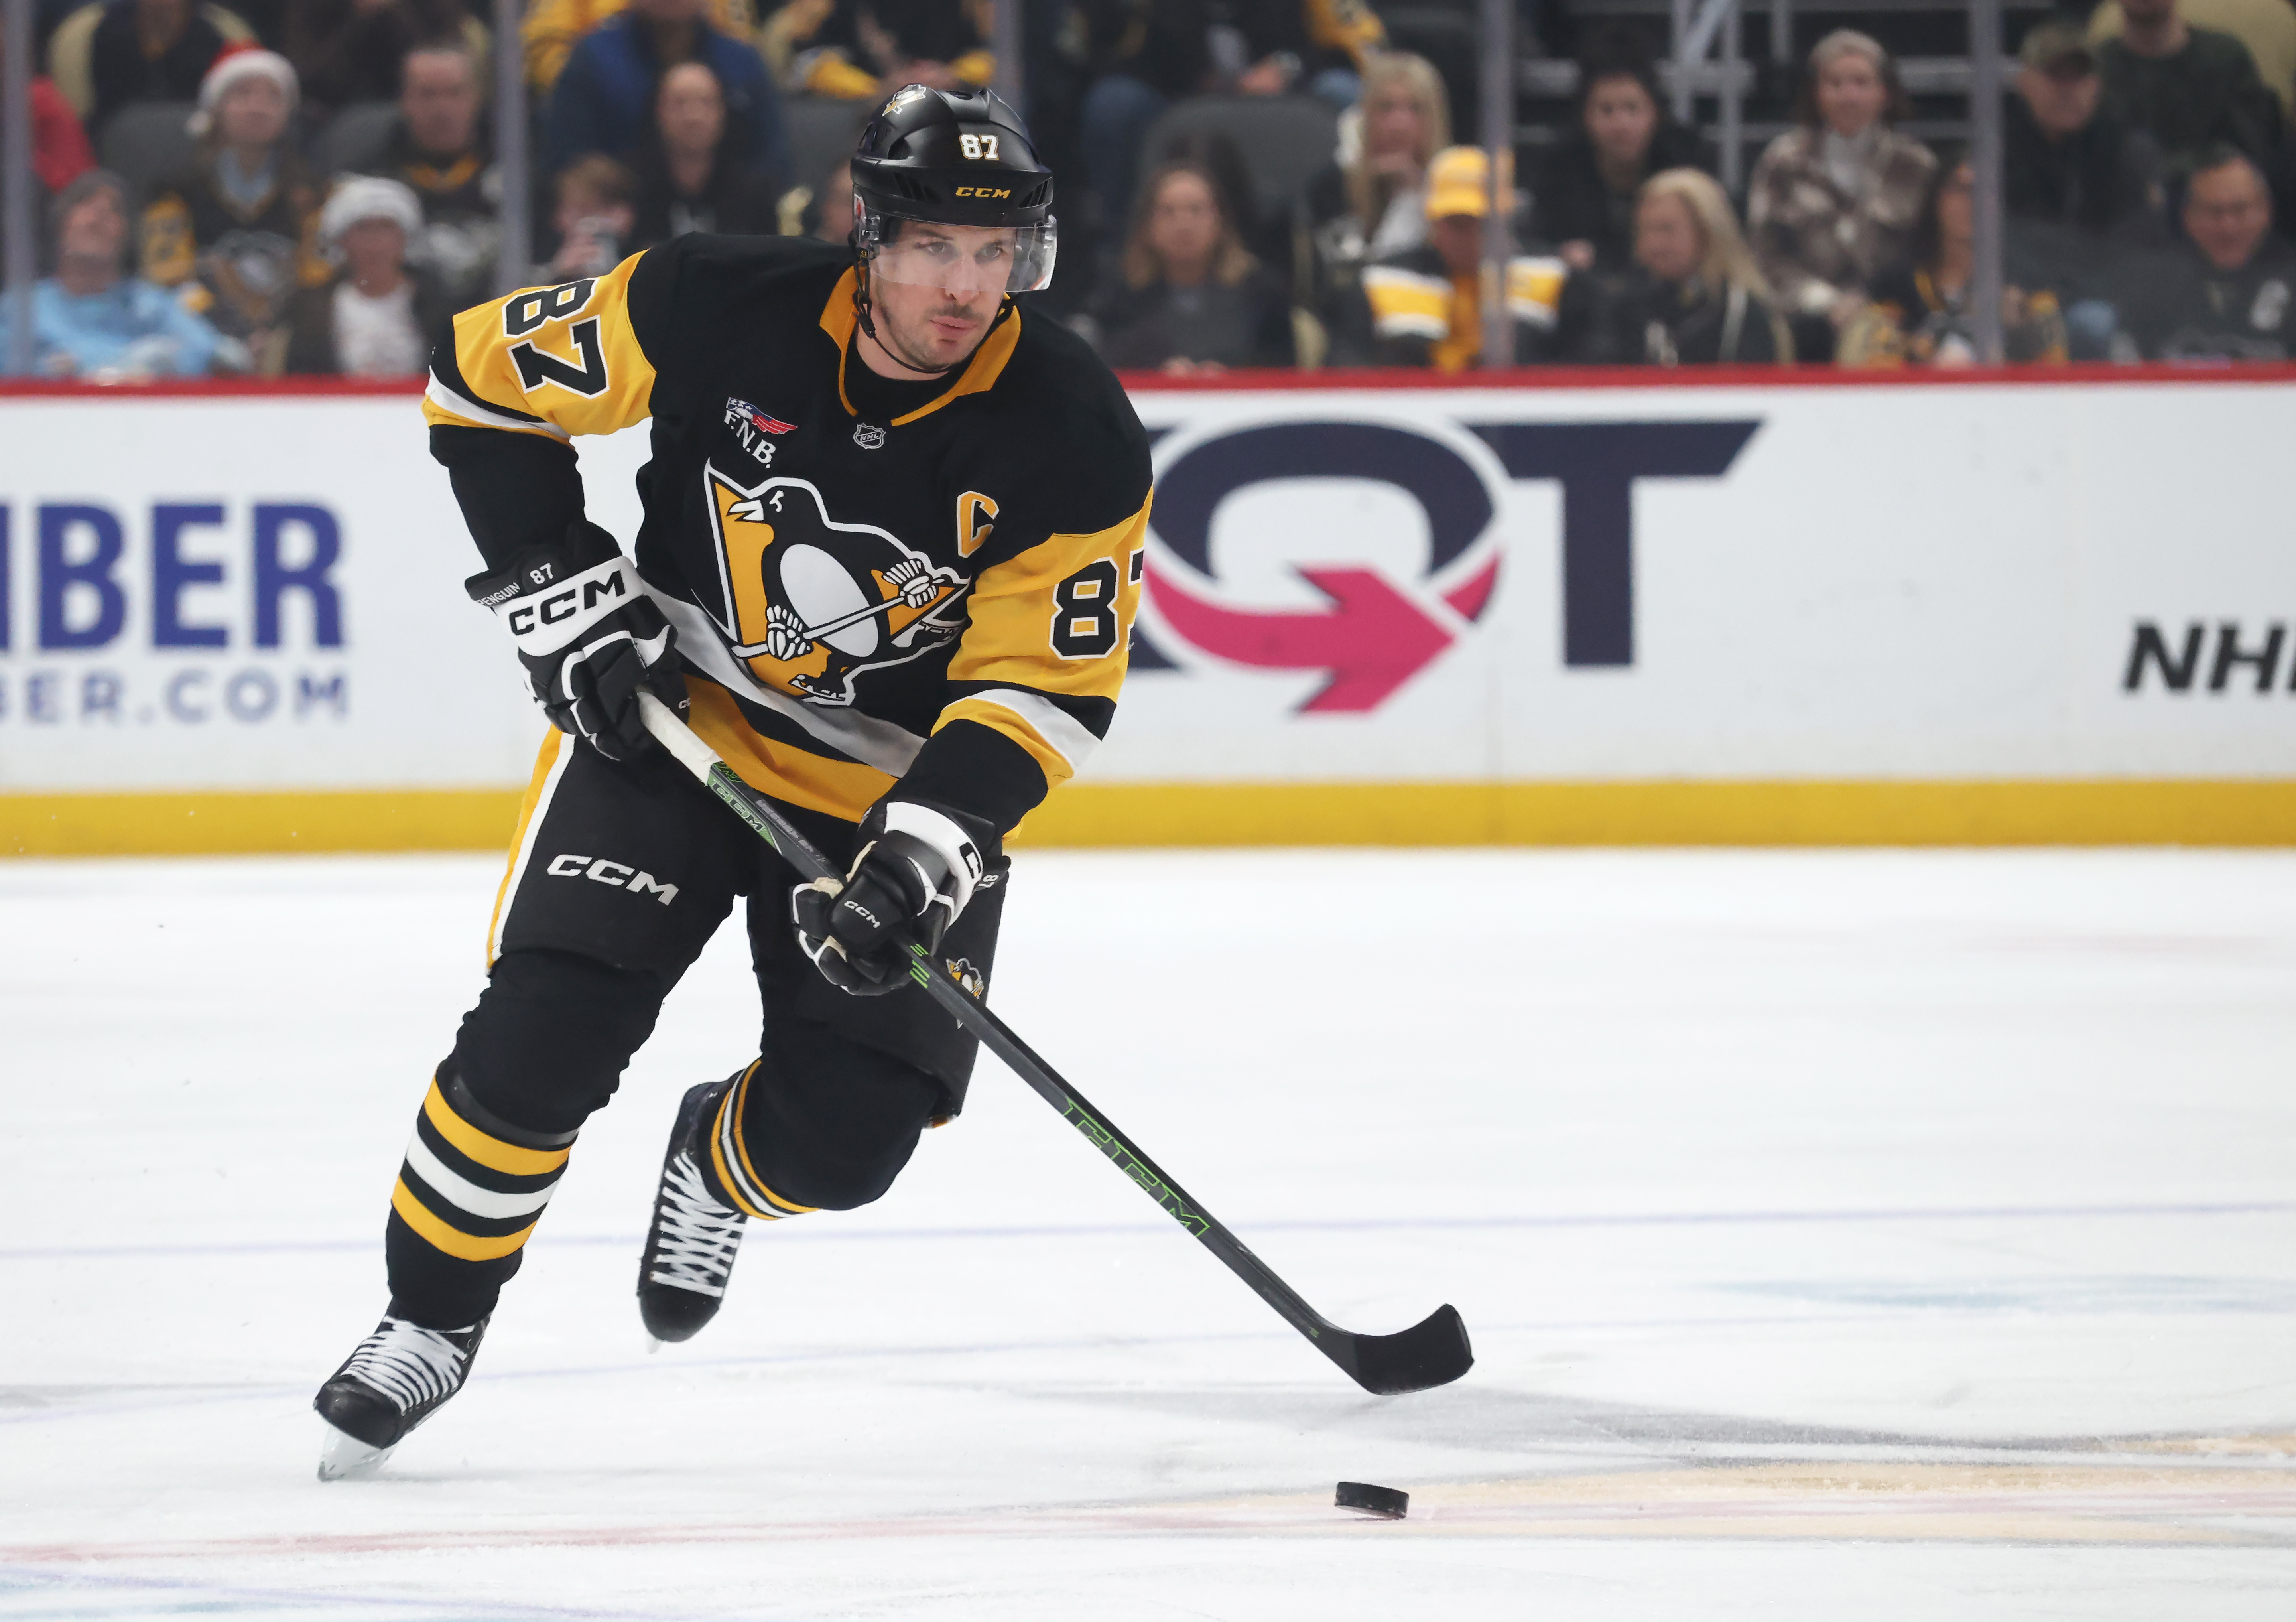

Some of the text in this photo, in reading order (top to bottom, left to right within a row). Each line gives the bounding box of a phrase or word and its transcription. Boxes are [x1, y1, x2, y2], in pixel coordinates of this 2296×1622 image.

[959, 133, 999, 160] 87
[955, 187, 1011, 199] CCM
[502, 278, 610, 399] 87
[724, 409, 776, 469] F.N.B.
[957, 491, 999, 558] C
[0, 503, 345, 650] BER
[477, 582, 521, 606] PENGUIN
[530, 563, 554, 584] 87
[508, 568, 626, 636] CCM
[2122, 624, 2296, 692] NH
[0, 671, 348, 724] ER.COM
[547, 854, 679, 905] CCM
[844, 901, 881, 928] CCM
